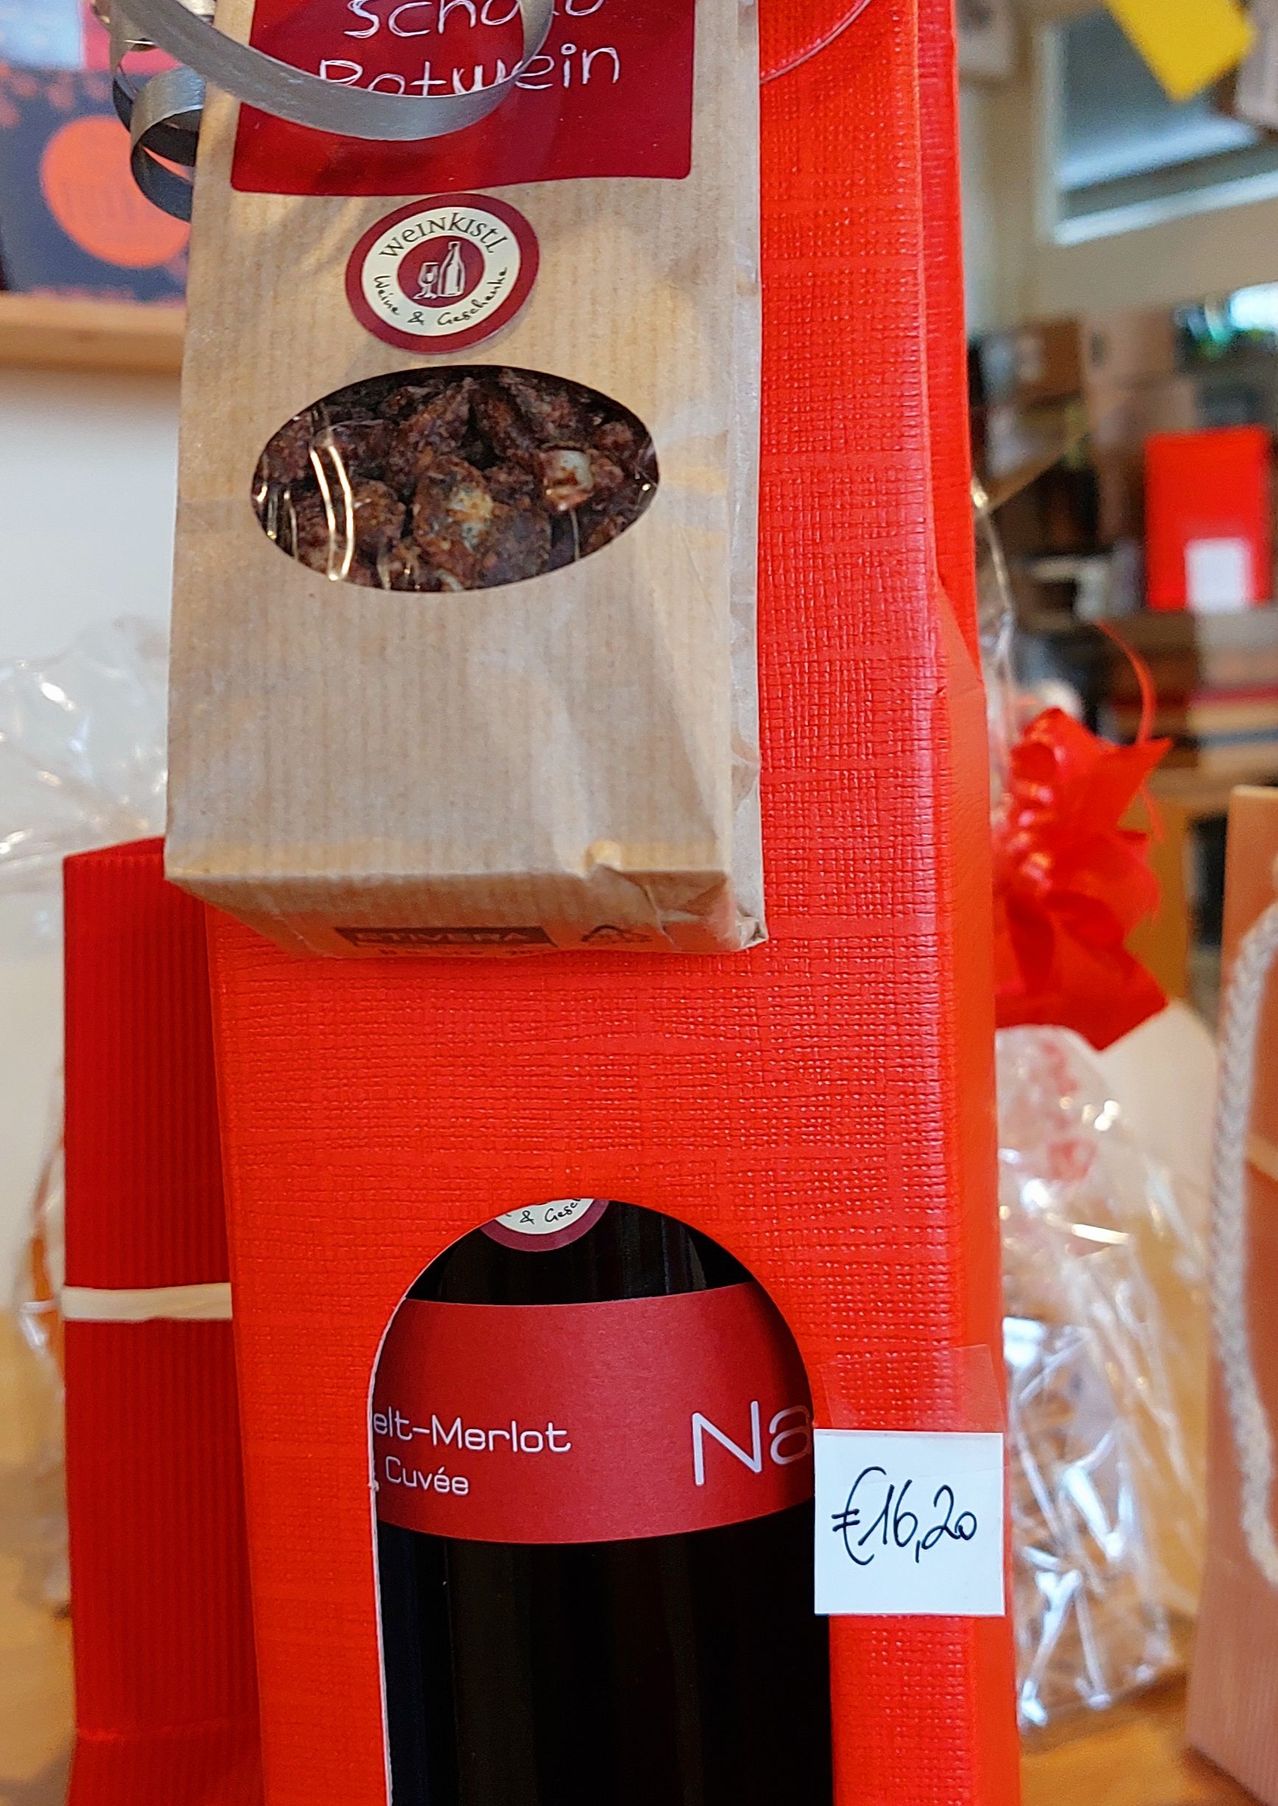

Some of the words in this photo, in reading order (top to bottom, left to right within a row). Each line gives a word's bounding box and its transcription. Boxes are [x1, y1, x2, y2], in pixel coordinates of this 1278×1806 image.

[373, 275, 401, 317] Weine
[407, 310, 426, 326] &
[437, 266, 508, 326] Geschenke
[519, 1209, 536, 1225] &
[385, 1455, 470, 1496] Cuvée
[831, 1465, 979, 1566] €16,20
